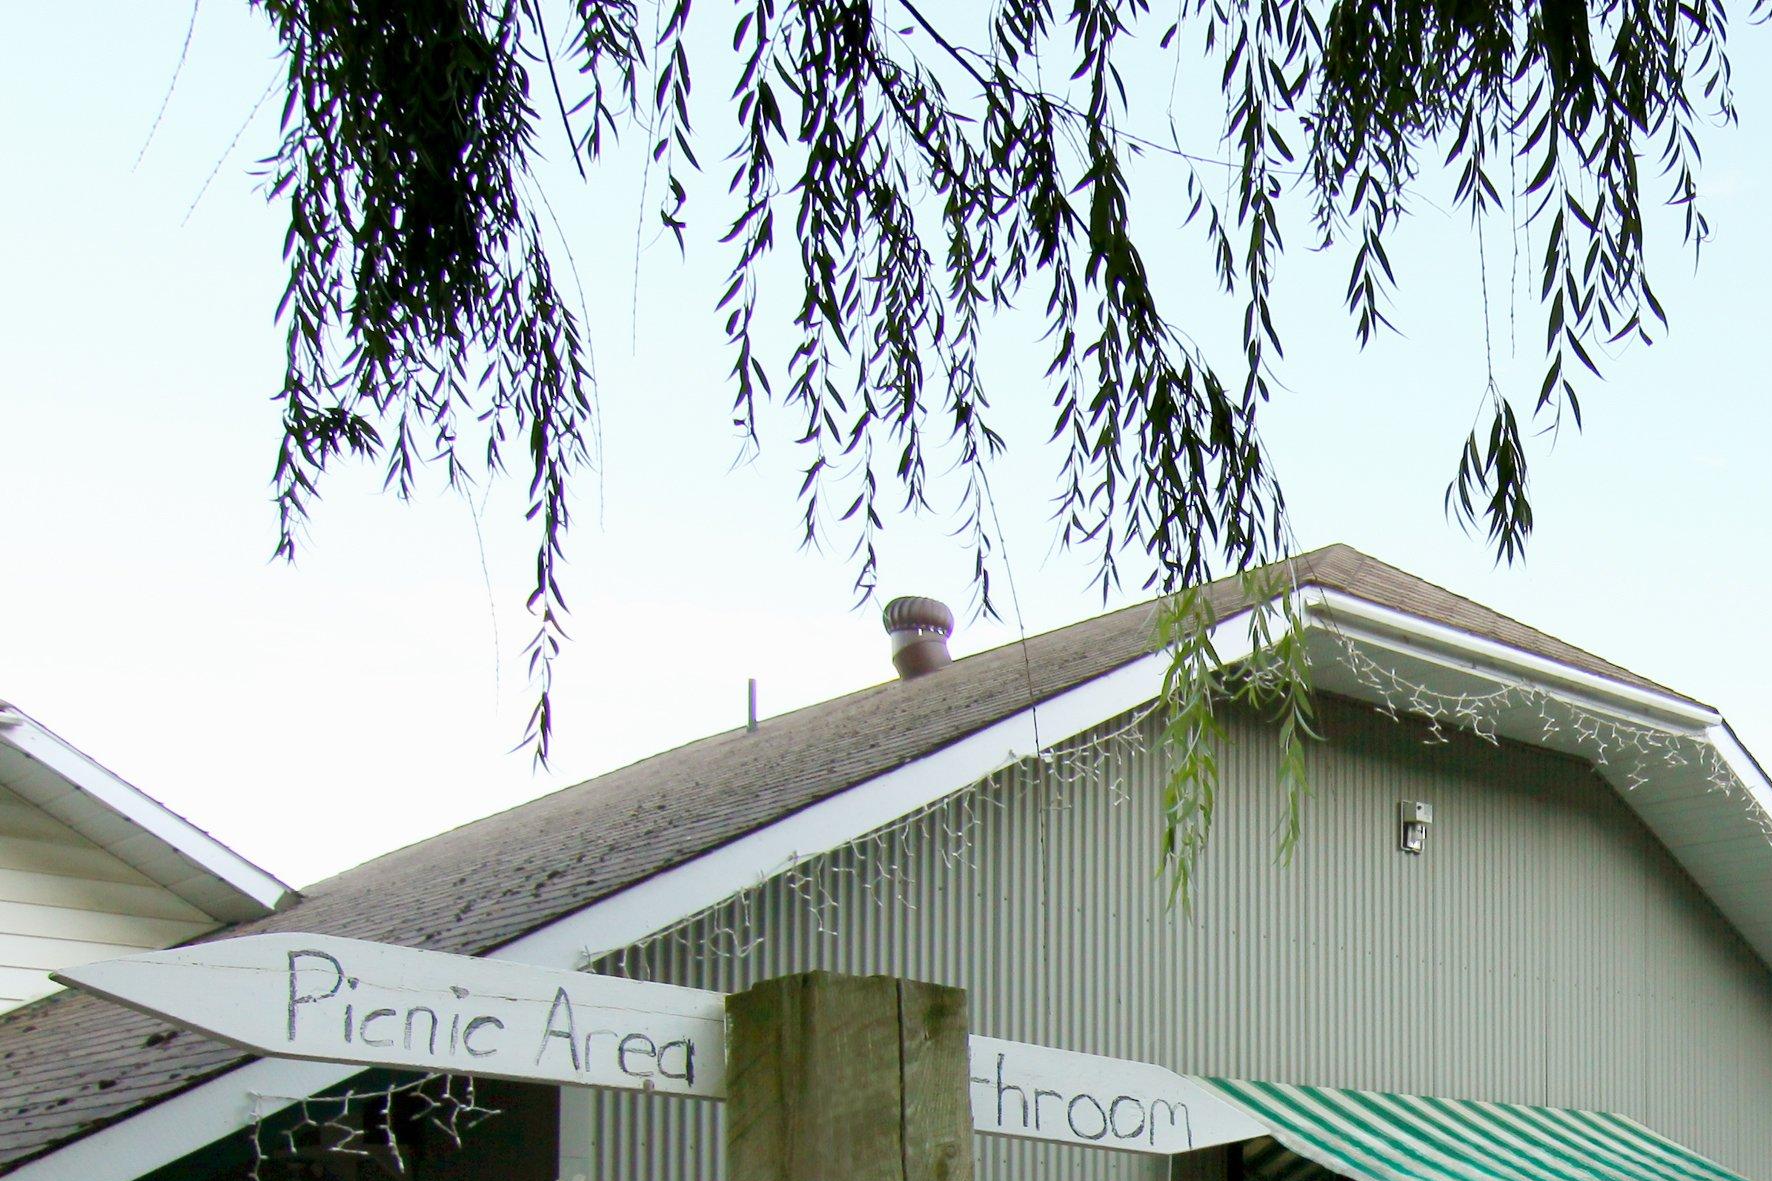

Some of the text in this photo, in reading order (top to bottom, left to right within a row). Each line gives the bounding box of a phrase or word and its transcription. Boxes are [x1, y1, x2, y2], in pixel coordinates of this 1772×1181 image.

[287, 948, 697, 1087] Picnic Area
[969, 1052, 1193, 1151] hroom
